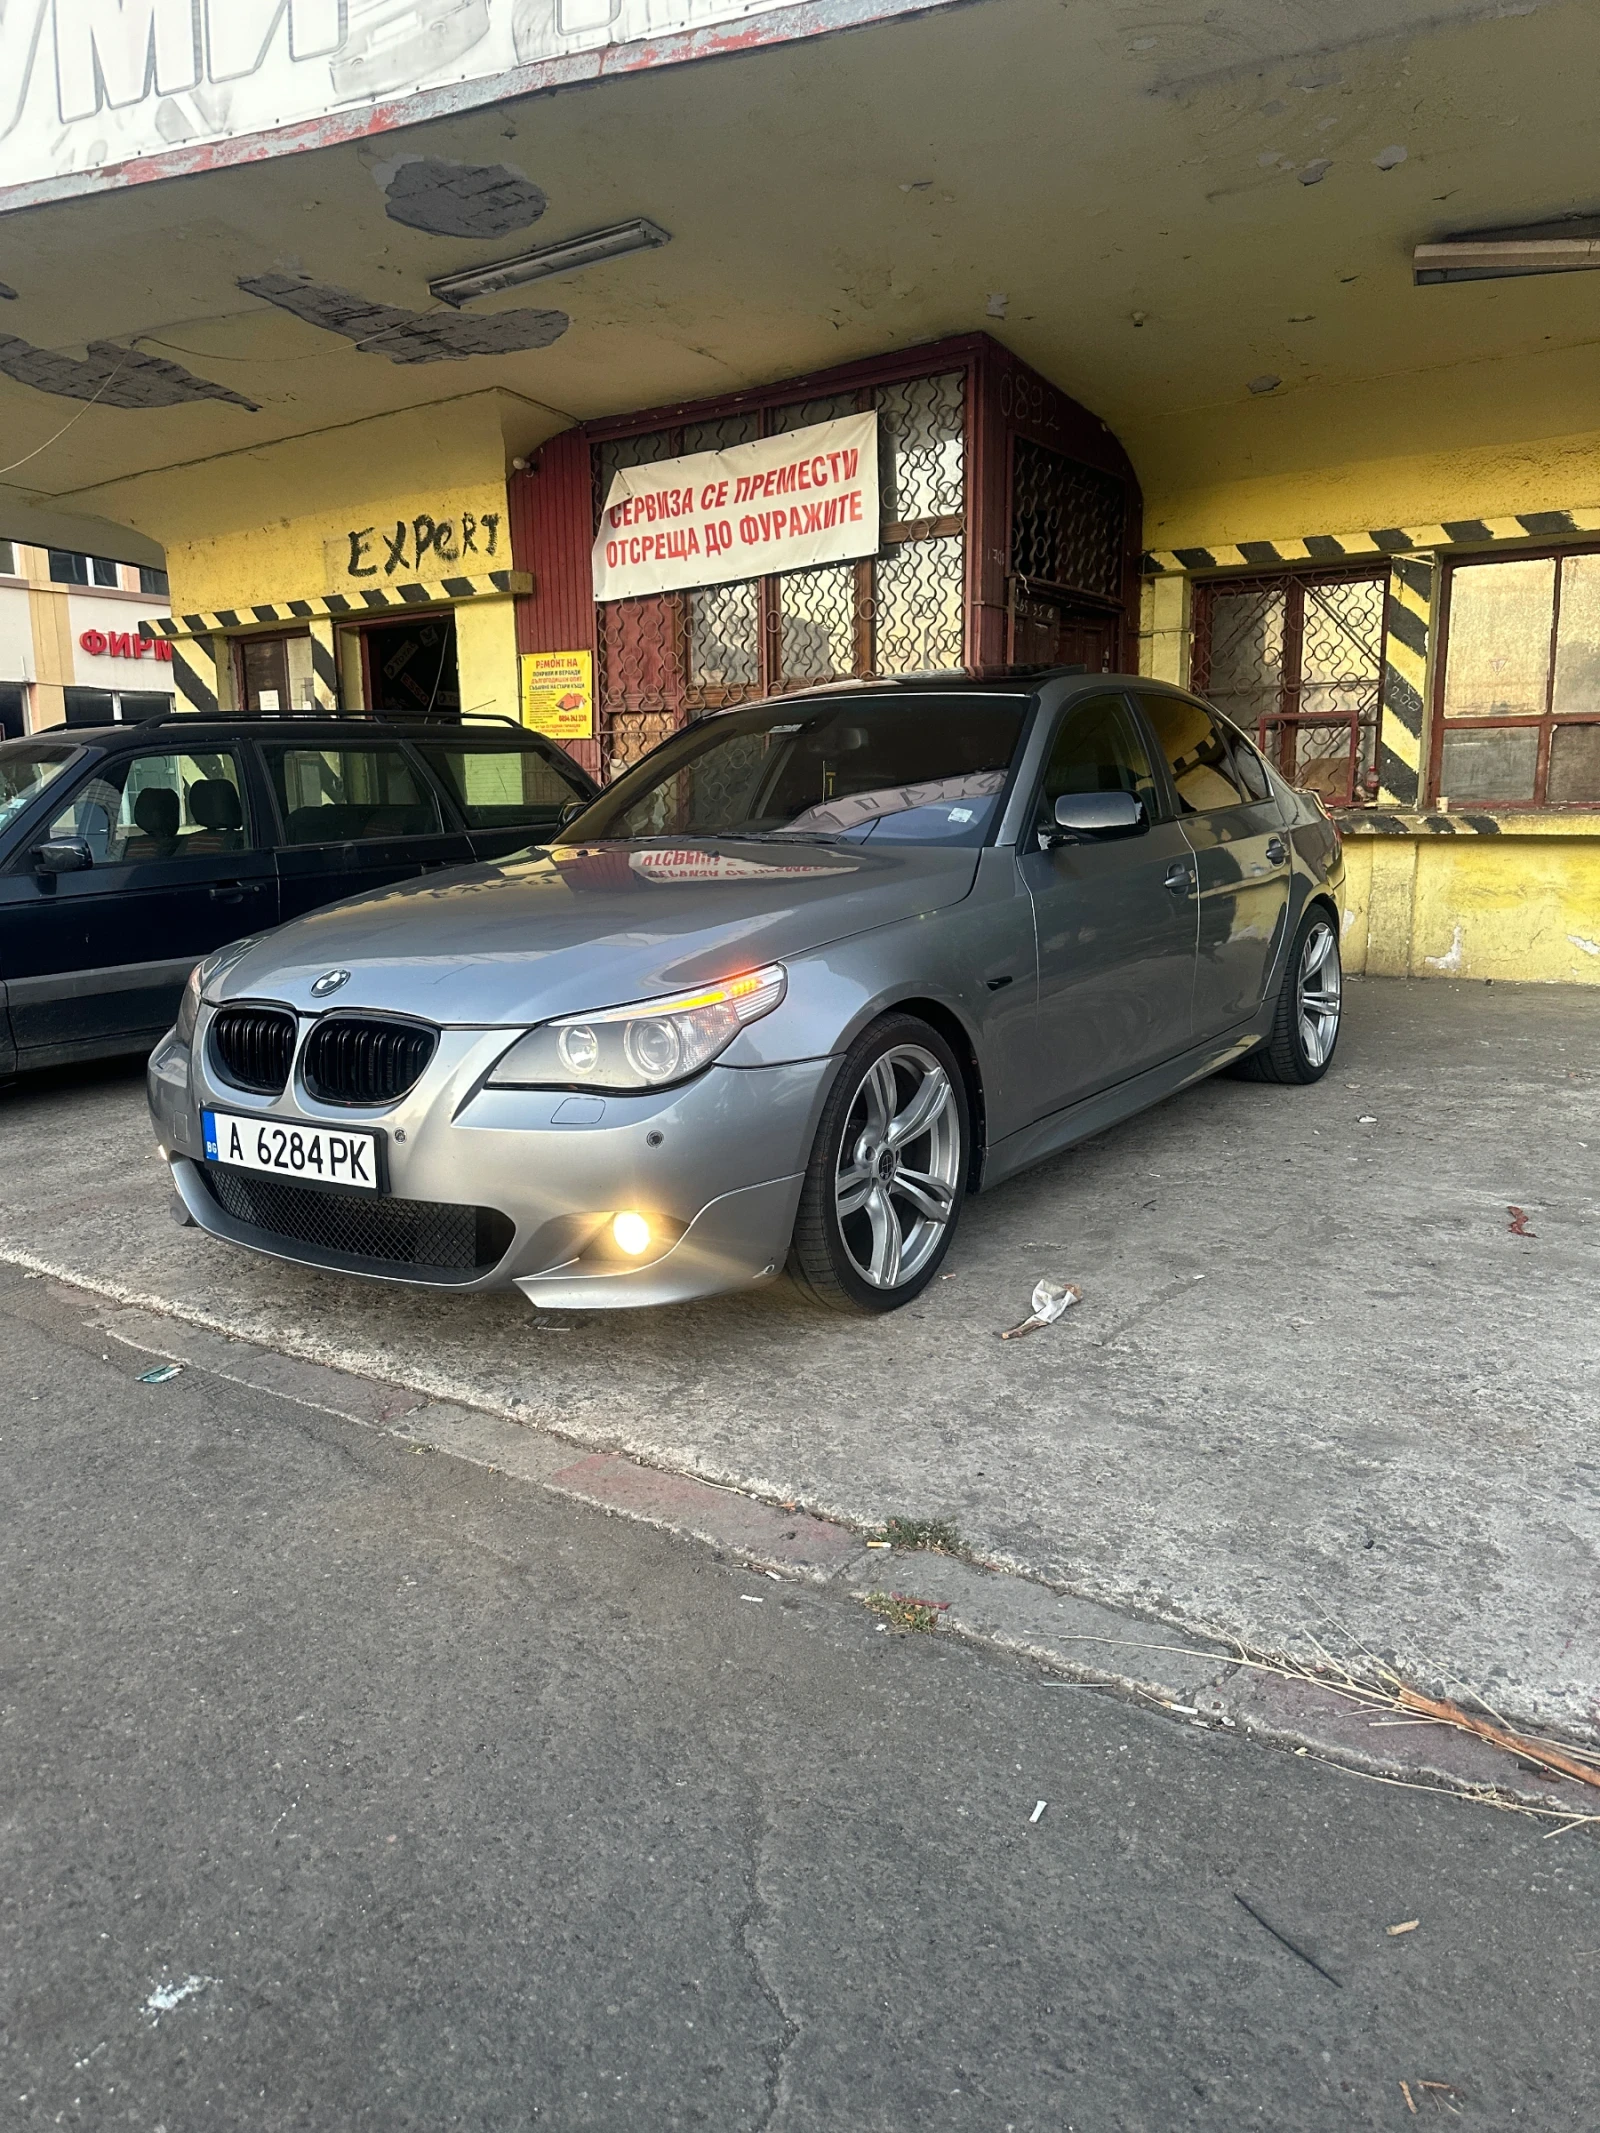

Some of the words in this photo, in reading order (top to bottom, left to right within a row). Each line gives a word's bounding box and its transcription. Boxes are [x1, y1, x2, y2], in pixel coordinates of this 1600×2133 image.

[609, 487, 694, 529] СЕРВИЗА
[700, 480, 729, 511] СЕ
[734, 447, 859, 505] ПРЕМЕСТИ
[606, 534, 700, 569] ОТСРЕЩА
[704, 520, 733, 558] ДО
[739, 489, 863, 546] ФУРАЖИТЕ
[536, 659, 565, 669] РЕМОНТ
[567, 659, 578, 667] НА
[206, 1140, 218, 1154] BG
[229, 1121, 244, 1161] A
